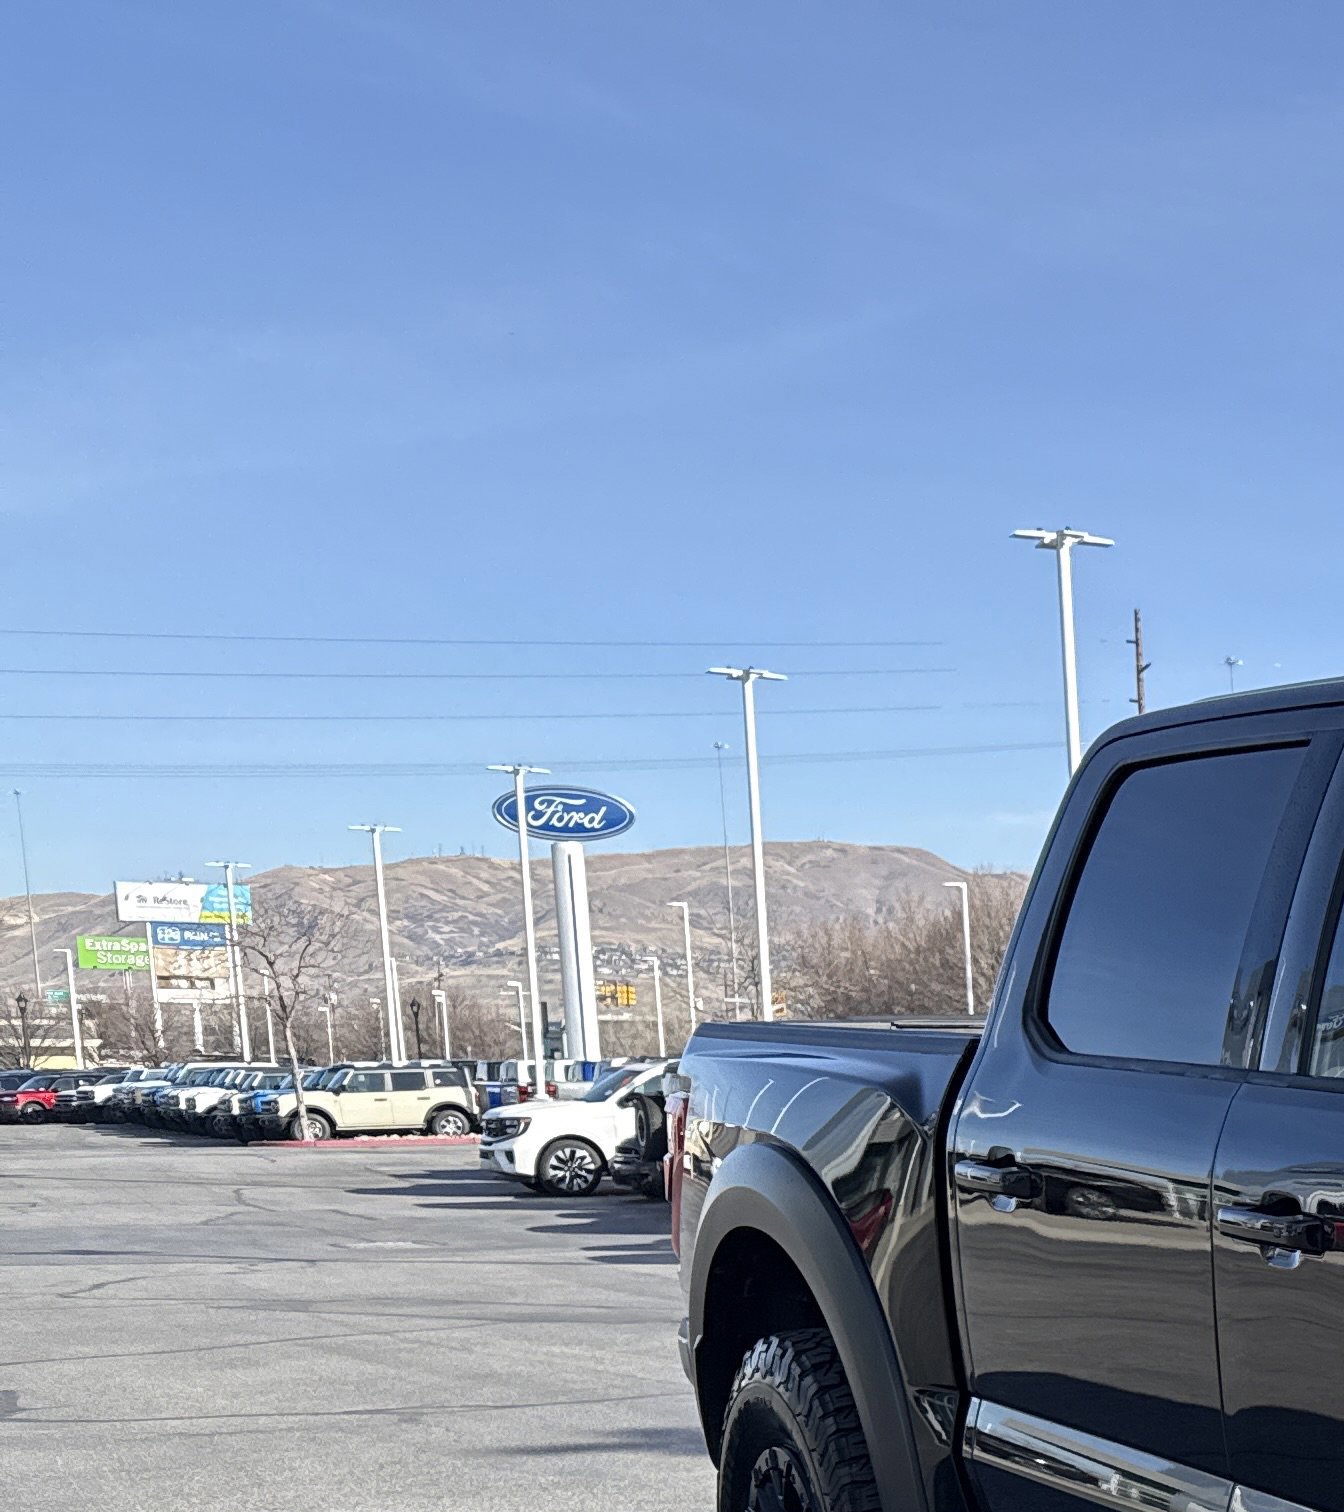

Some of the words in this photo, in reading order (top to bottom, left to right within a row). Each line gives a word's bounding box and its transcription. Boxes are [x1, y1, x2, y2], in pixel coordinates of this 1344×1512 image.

[527, 795, 607, 829] Ford
[184, 930, 221, 942] PAIN
[84, 937, 148, 954] ExtraSpa
